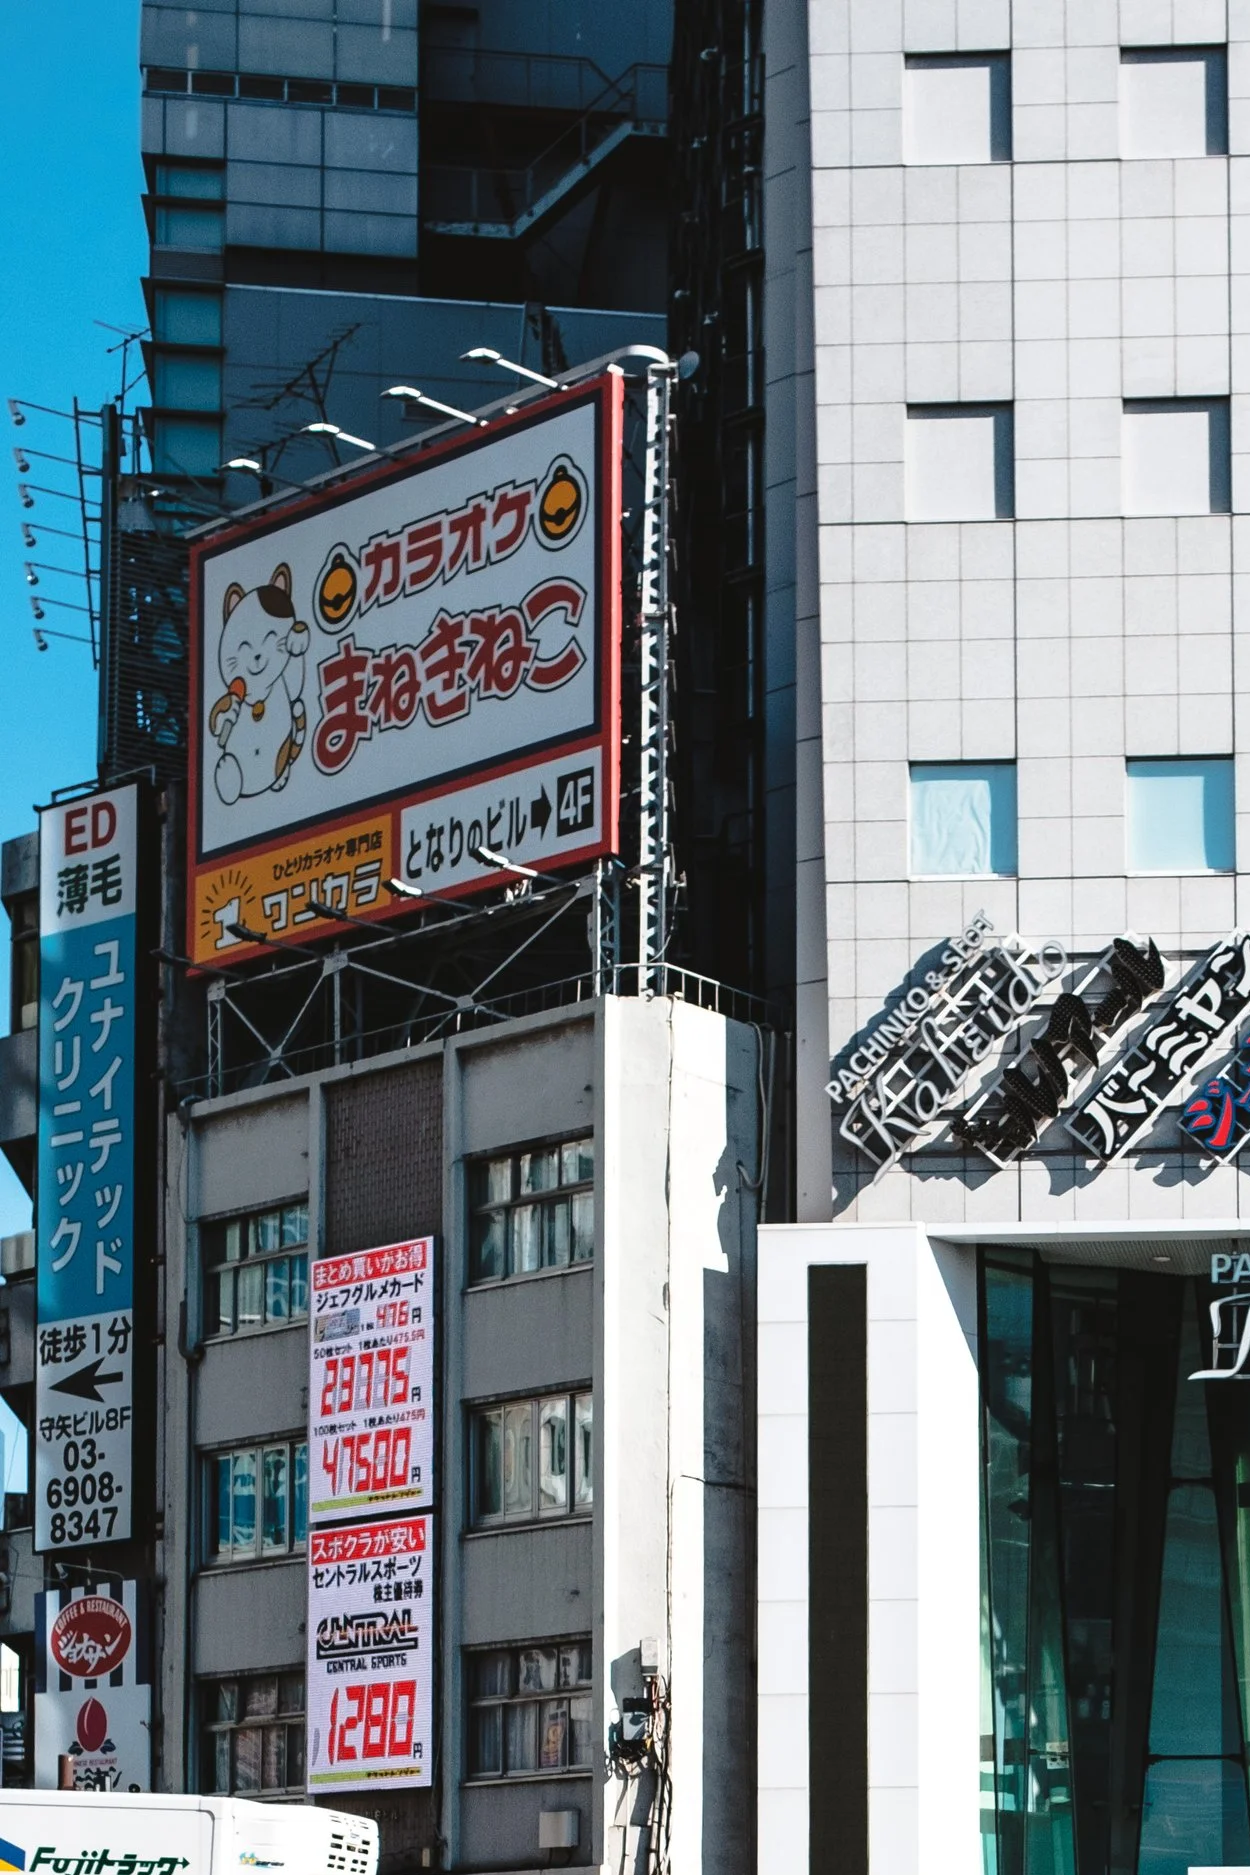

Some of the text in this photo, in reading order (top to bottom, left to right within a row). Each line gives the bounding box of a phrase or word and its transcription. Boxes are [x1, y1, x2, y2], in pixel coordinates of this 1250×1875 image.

[362, 487, 536, 602] カラオケ
[313, 578, 587, 774] まねきねこ
[64, 800, 117, 857] ED
[405, 775, 592, 879] となりのビル 4F
[272, 830, 383, 882] ひとりカラオケ専門店
[57, 854, 123, 918] 薄毛
[261, 859, 384, 932] ワンカラ
[823, 986, 930, 1104] PACHINKO
[943, 908, 996, 971] SLOT
[839, 939, 1068, 1186] Kaleido
[49, 975, 86, 1274] クリニック
[88, 939, 125, 1295] ユナイテッド
[315, 1244, 423, 1287] まとめ買いがお得
[316, 1272, 425, 1312] ジェフグルメカード
[376, 1300, 409, 1328] 476
[411, 1306, 422, 1324] 円
[39, 1315, 132, 1366] 徒歩1分
[313, 1343, 353, 1360] 50枚セット
[320, 1346, 421, 1418] 23775 円
[40, 1406, 132, 1443] 守矢ビル8F
[62, 1437, 106, 1473] 03-
[322, 1426, 421, 1496] 47500 円
[46, 1469, 123, 1510] 6908-
[49, 1506, 119, 1543] 8347
[312, 1525, 425, 1562] スポクラが安い
[313, 1555, 422, 1589] セントラルスポーツ
[373, 1580, 423, 1604] 株主優待券
[58, 1629, 123, 1673] ジョナサン
[326, 1653, 407, 1674] CENTRAL SPORTS
[328, 1679, 417, 1767] 1280
